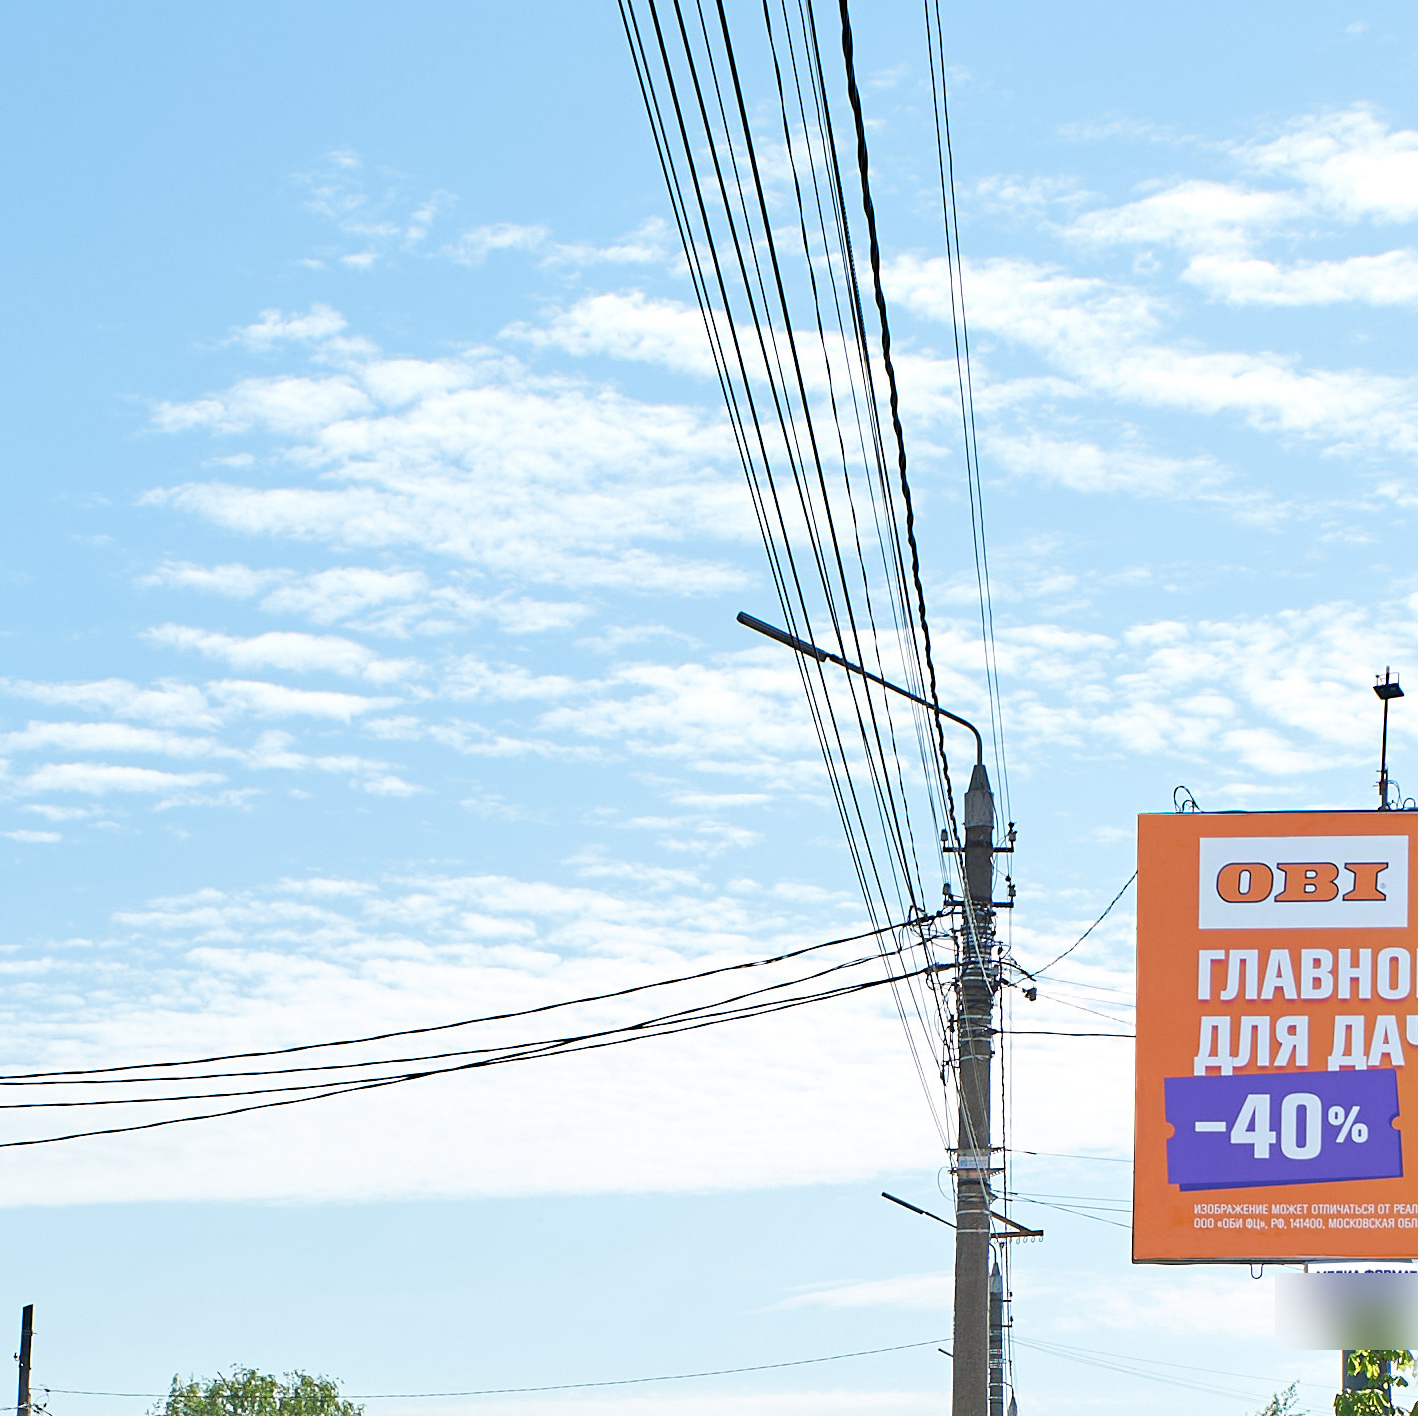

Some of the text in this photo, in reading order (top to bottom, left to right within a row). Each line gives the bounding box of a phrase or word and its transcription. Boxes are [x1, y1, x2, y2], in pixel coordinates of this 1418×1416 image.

[1216, 862, 1390, 904] OBI
[1193, 1015, 1309, 1077] ДЛЯ
[1193, 1203, 1269, 1215] ИЗОБРАЖЕНИЕ
[1271, 1203, 1309, 1215] МОЖЕТ
[1310, 1203, 1375, 1215] ОТЛИЧАТЬСЯ
[1193, 1217, 1215, 1229] ООО
[1216, 1217, 1244, 1229] «ОБИ
[1244, 1217, 1269, 1230] ФЦ»,
[1270, 1217, 1288, 1230] РФ,
[1289, 1217, 1327, 1230] 141400,
[1328, 1217, 1395, 1229] МОСКОВСКАЯ
